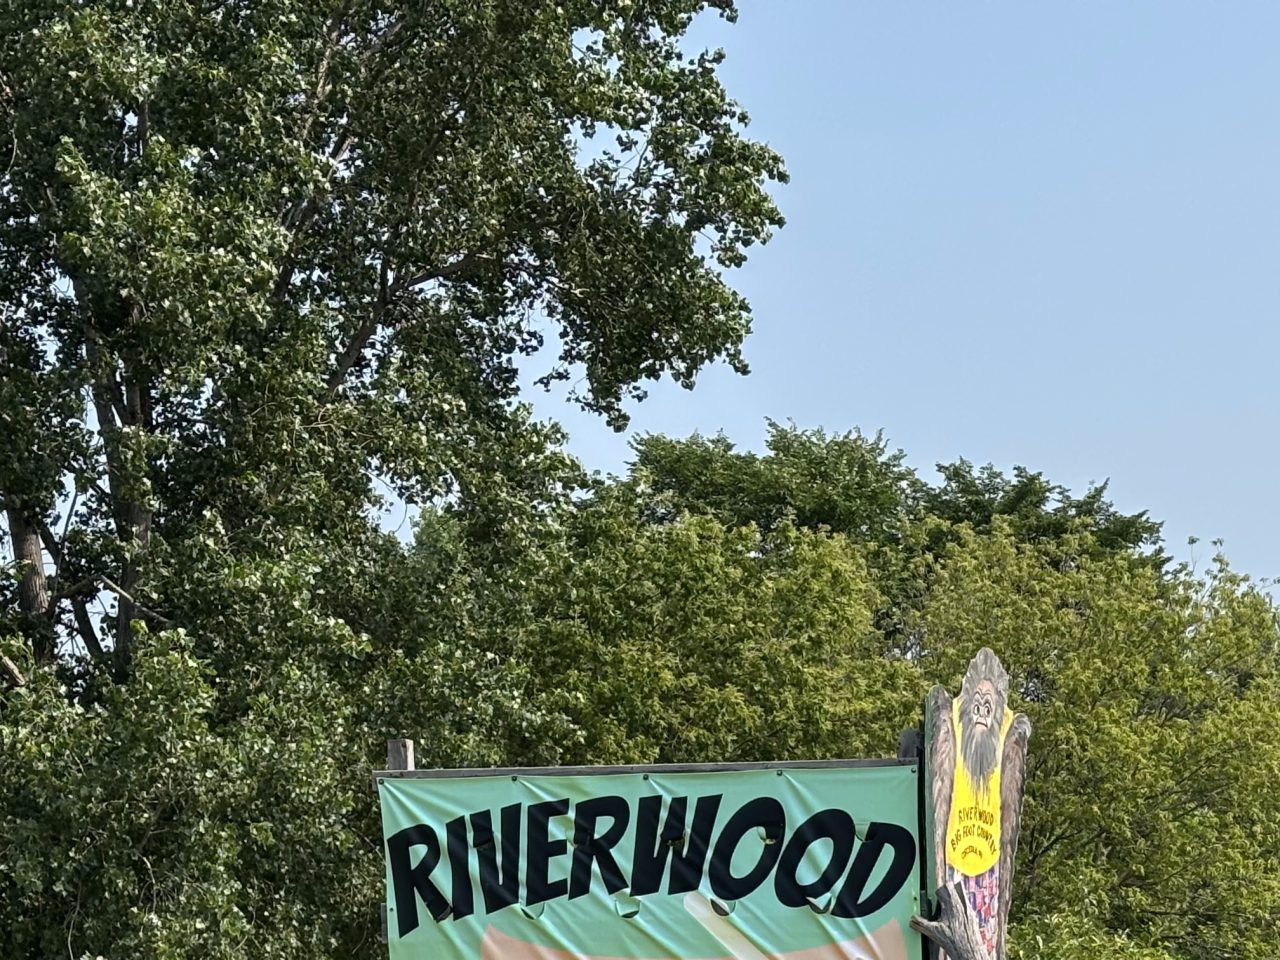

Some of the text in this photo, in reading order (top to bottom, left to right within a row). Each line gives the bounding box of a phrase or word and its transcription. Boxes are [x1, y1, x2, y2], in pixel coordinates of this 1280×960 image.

[958, 806, 994, 826] RIVERWOOD
[951, 829, 961, 852] BIG
[387, 794, 917, 938] RIVERWOOD
